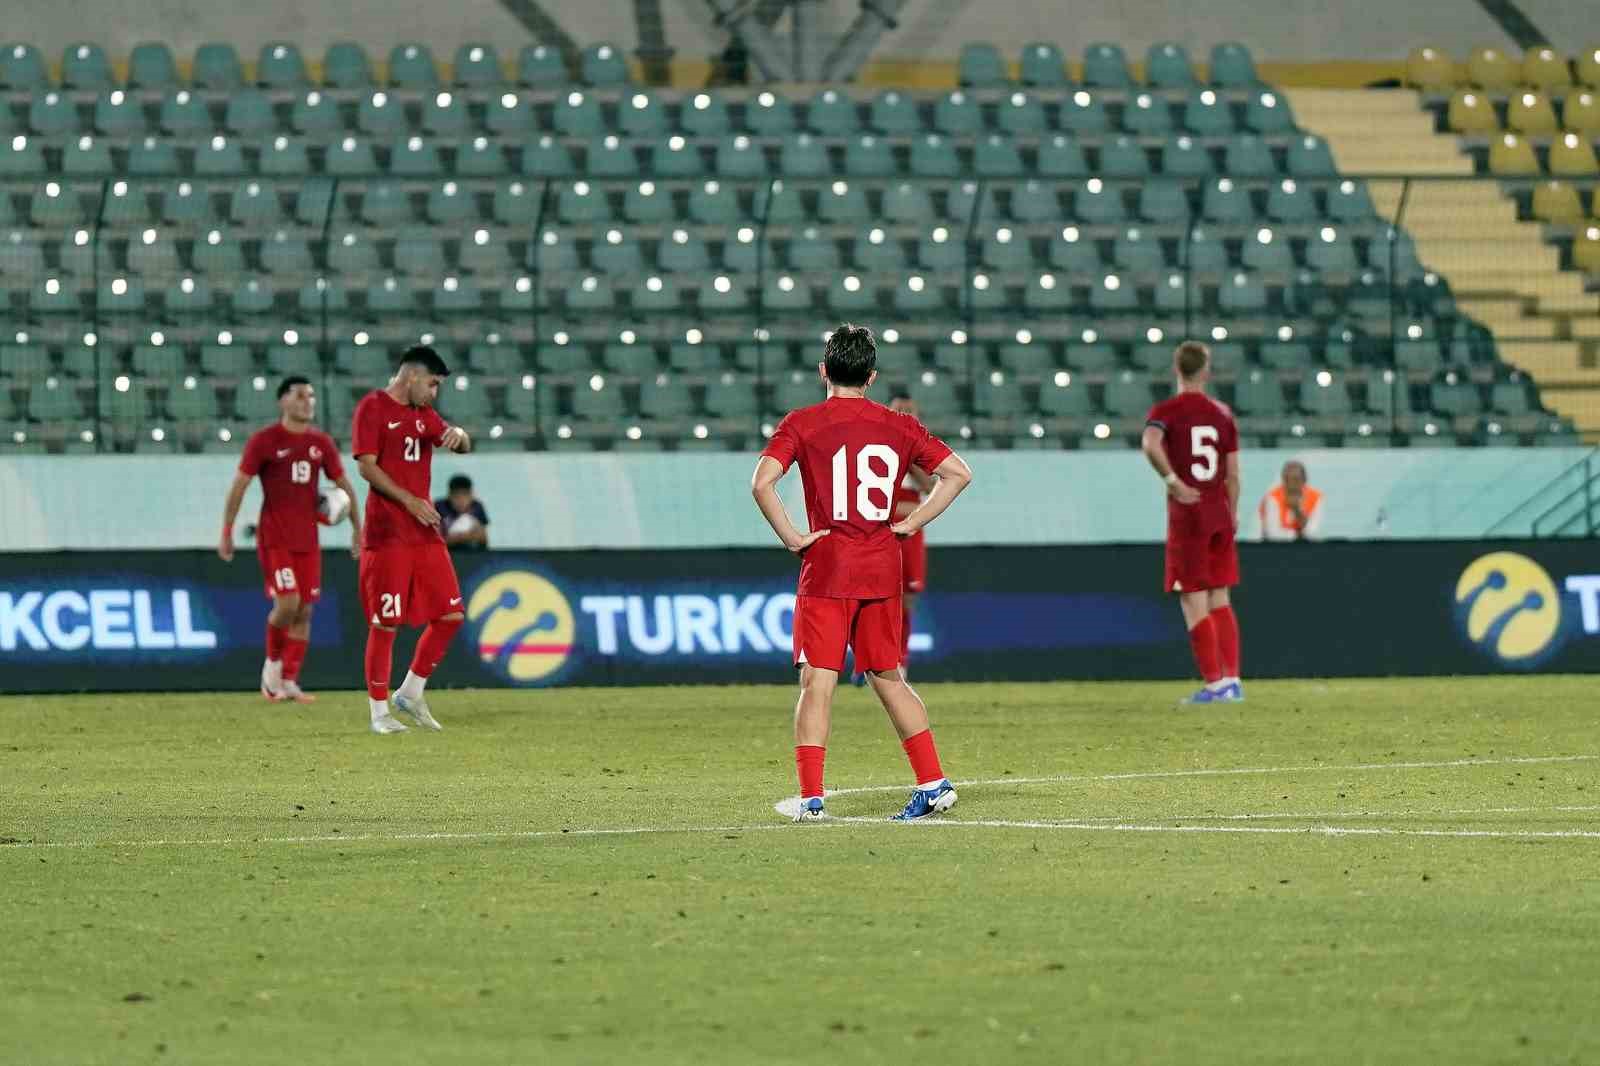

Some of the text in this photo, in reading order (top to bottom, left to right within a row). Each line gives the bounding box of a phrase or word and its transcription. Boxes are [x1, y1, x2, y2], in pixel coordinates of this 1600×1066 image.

[404, 435, 420, 461] 21
[1190, 425, 1219, 481] 5
[291, 460, 311, 484] 19
[832, 444, 900, 521] 18
[274, 567, 296, 590] 19
[0, 589, 217, 650] KCELL
[380, 592, 401, 618] 21
[580, 592, 933, 655] TURKC
